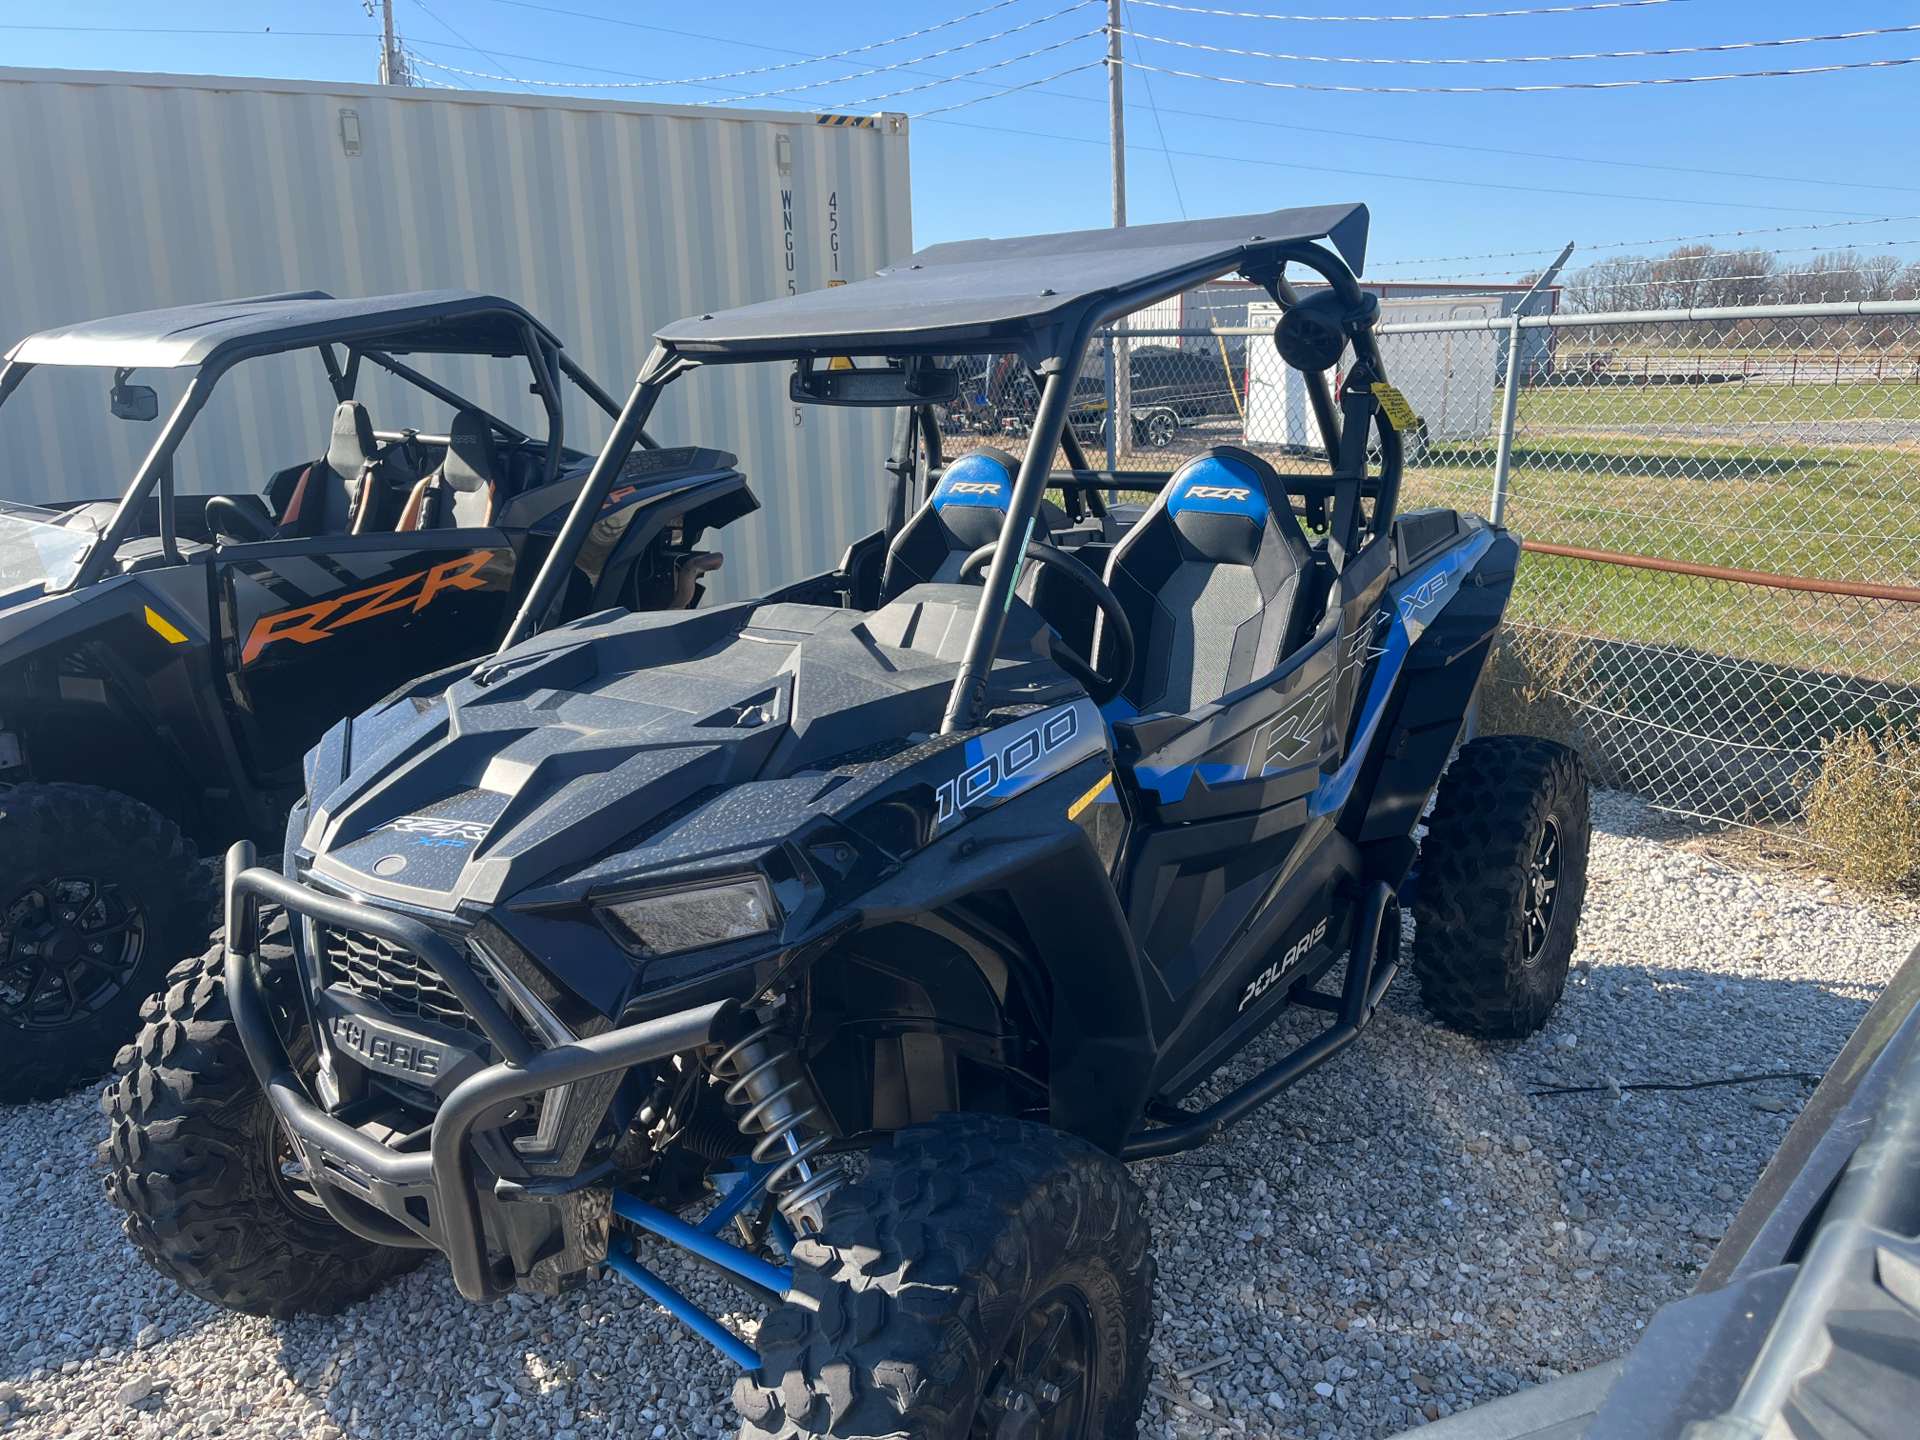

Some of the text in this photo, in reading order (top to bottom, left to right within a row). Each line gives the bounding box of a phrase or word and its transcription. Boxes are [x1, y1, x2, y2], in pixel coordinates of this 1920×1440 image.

[781, 190, 794, 271] WNGU
[829, 191, 838, 272] 45G1
[948, 482, 1001, 495] RZR
[1183, 485, 1251, 501] RZR
[242, 550, 494, 665] RZR
[1398, 571, 1448, 623] XP
[936, 705, 1079, 823] 1000
[366, 815, 492, 840] RZR
[409, 836, 468, 847] XP
[1238, 916, 1328, 1012] POLARIS
[333, 1011, 440, 1078] POLARIS
